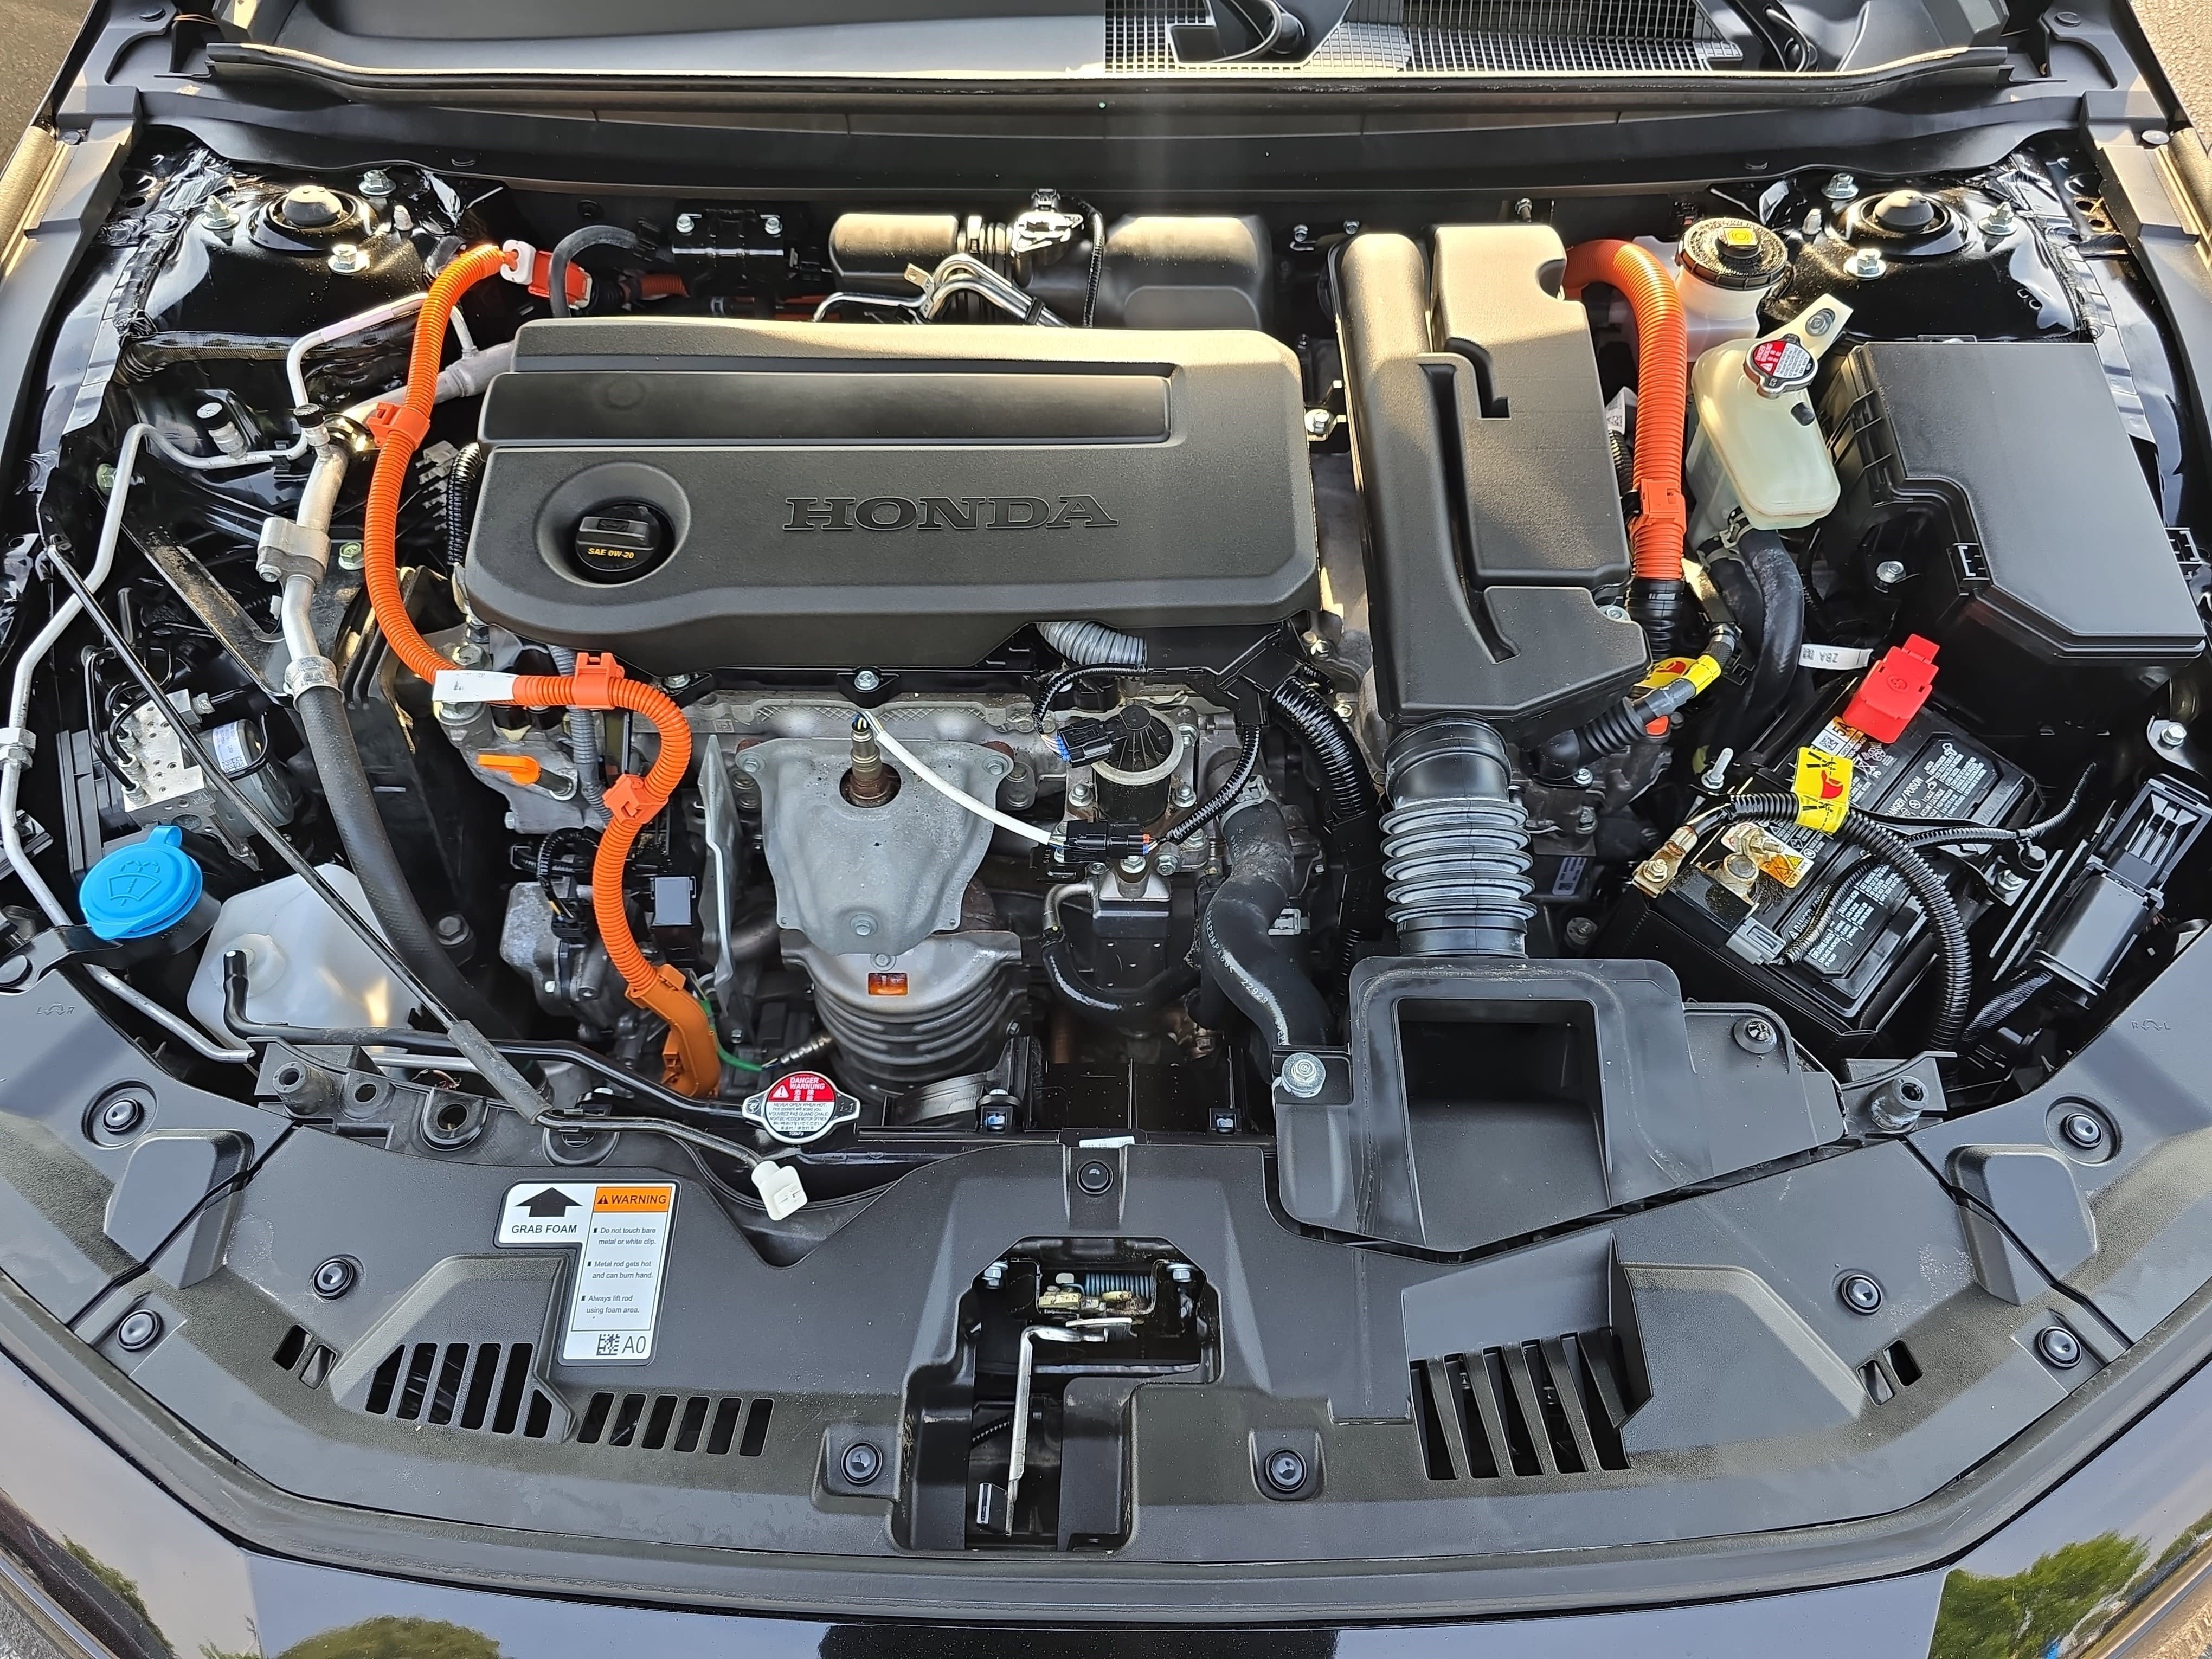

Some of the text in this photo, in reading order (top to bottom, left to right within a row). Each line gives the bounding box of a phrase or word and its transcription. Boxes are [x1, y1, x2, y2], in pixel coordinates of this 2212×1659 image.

[782, 494, 1119, 530] HONDA
[587, 548, 606, 556] SAE
[1902, 775, 1924, 796] POISON
[1240, 978, 1269, 1004] 22929
[66, 1006, 75, 1014] R
[2131, 1021, 2171, 1030] R L
[612, 1195, 666, 1204] WARNING
[512, 1225, 577, 1233] GRAB FOAM
[622, 1335, 646, 1354] A0
